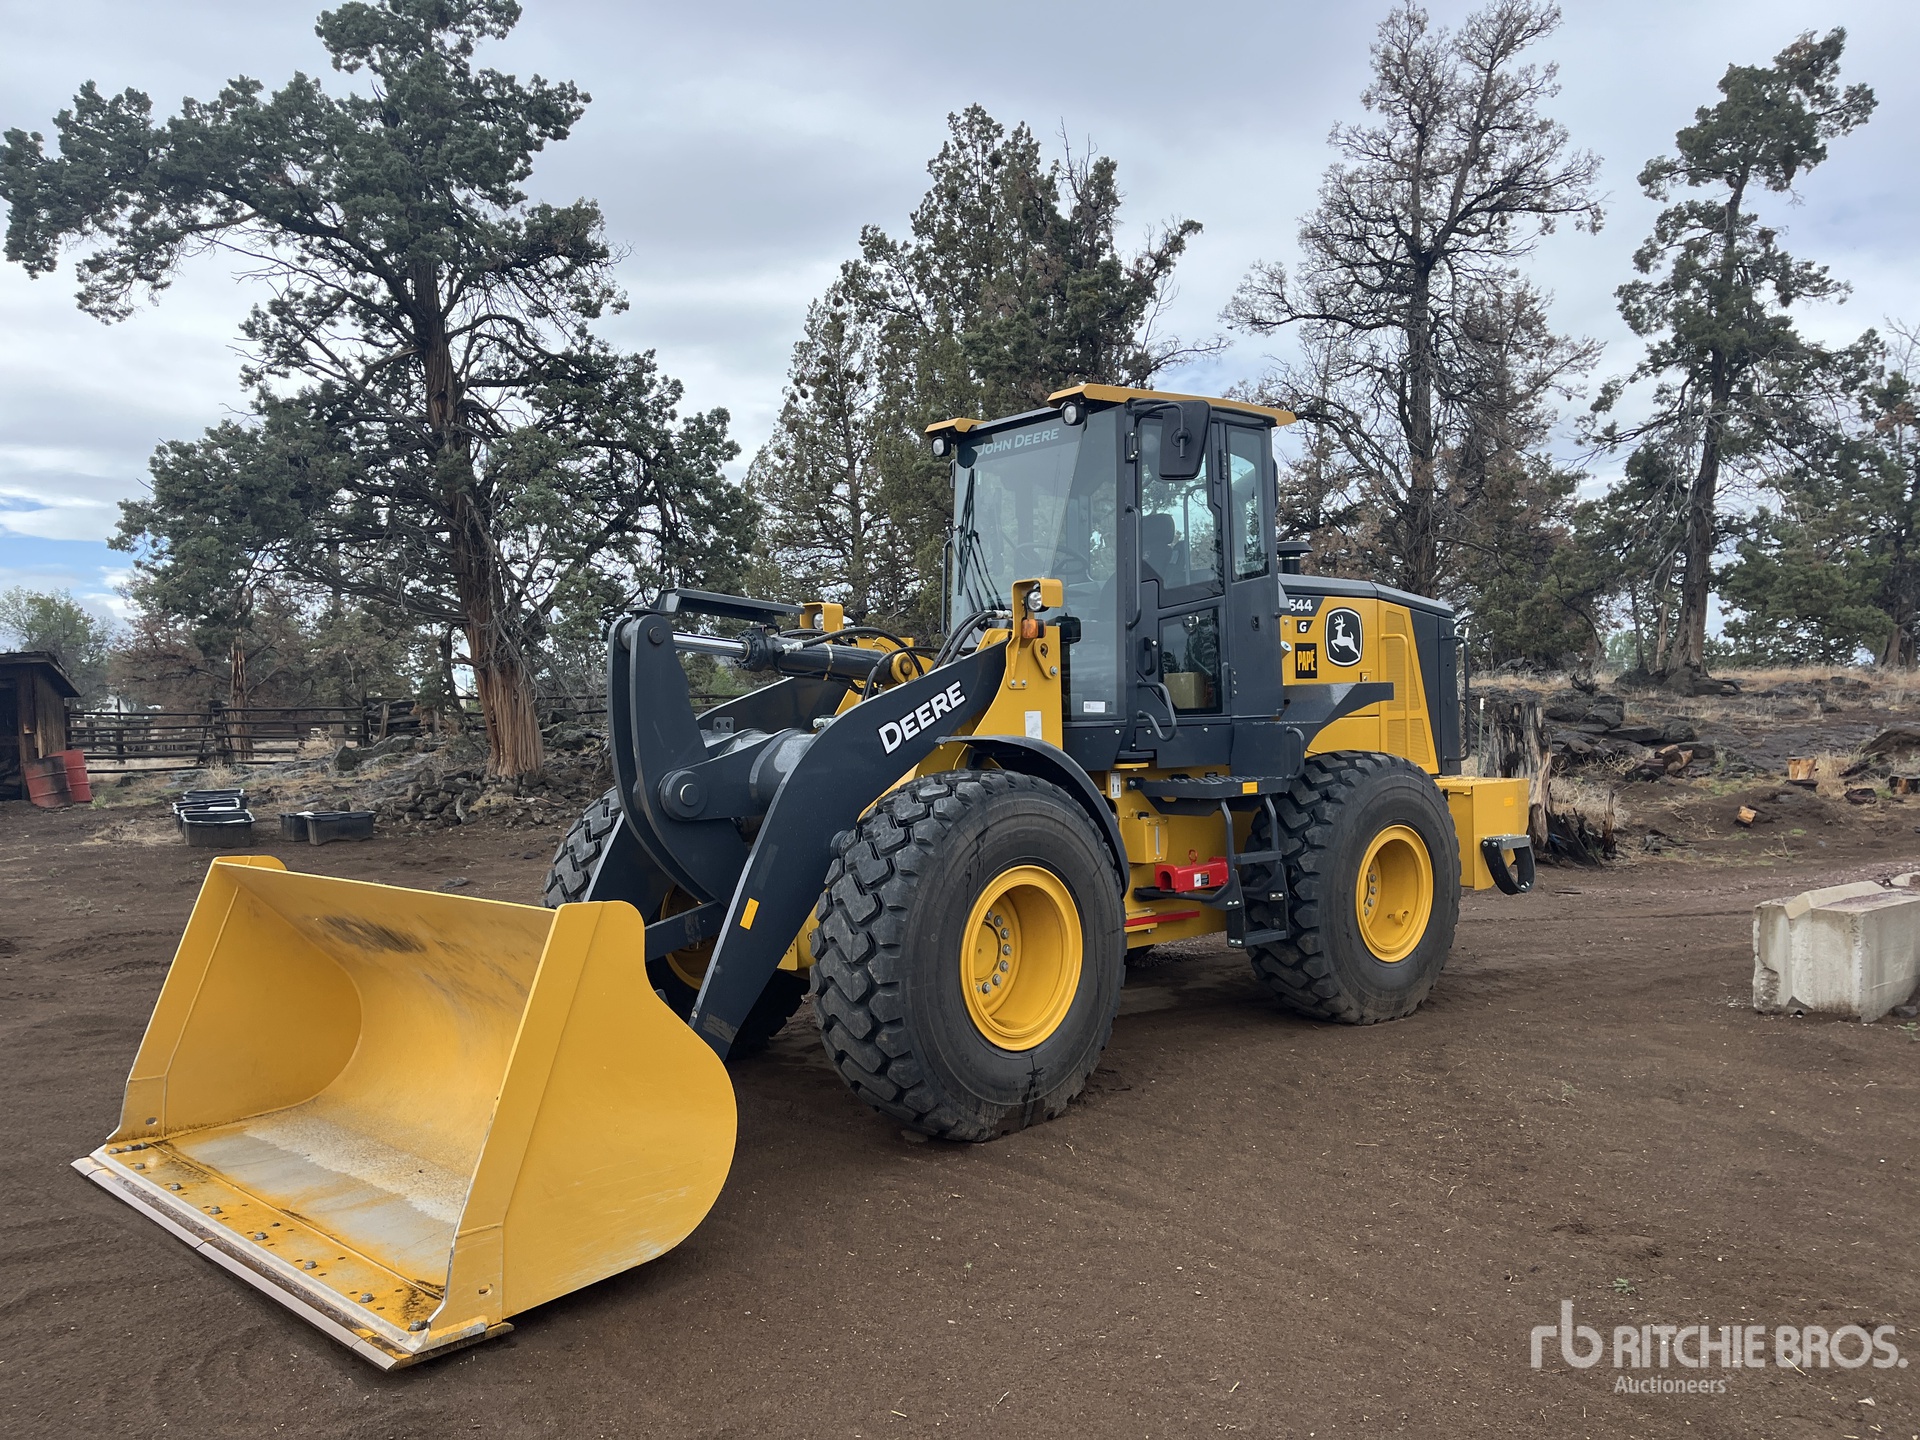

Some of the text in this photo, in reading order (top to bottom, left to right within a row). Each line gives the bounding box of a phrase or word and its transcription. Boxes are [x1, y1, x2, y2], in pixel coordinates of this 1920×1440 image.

[977, 427, 1060, 456] JOHN DEERE
[1288, 599, 1313, 612] 544
[1299, 621, 1308, 633] G
[878, 680, 966, 754] DEERE
